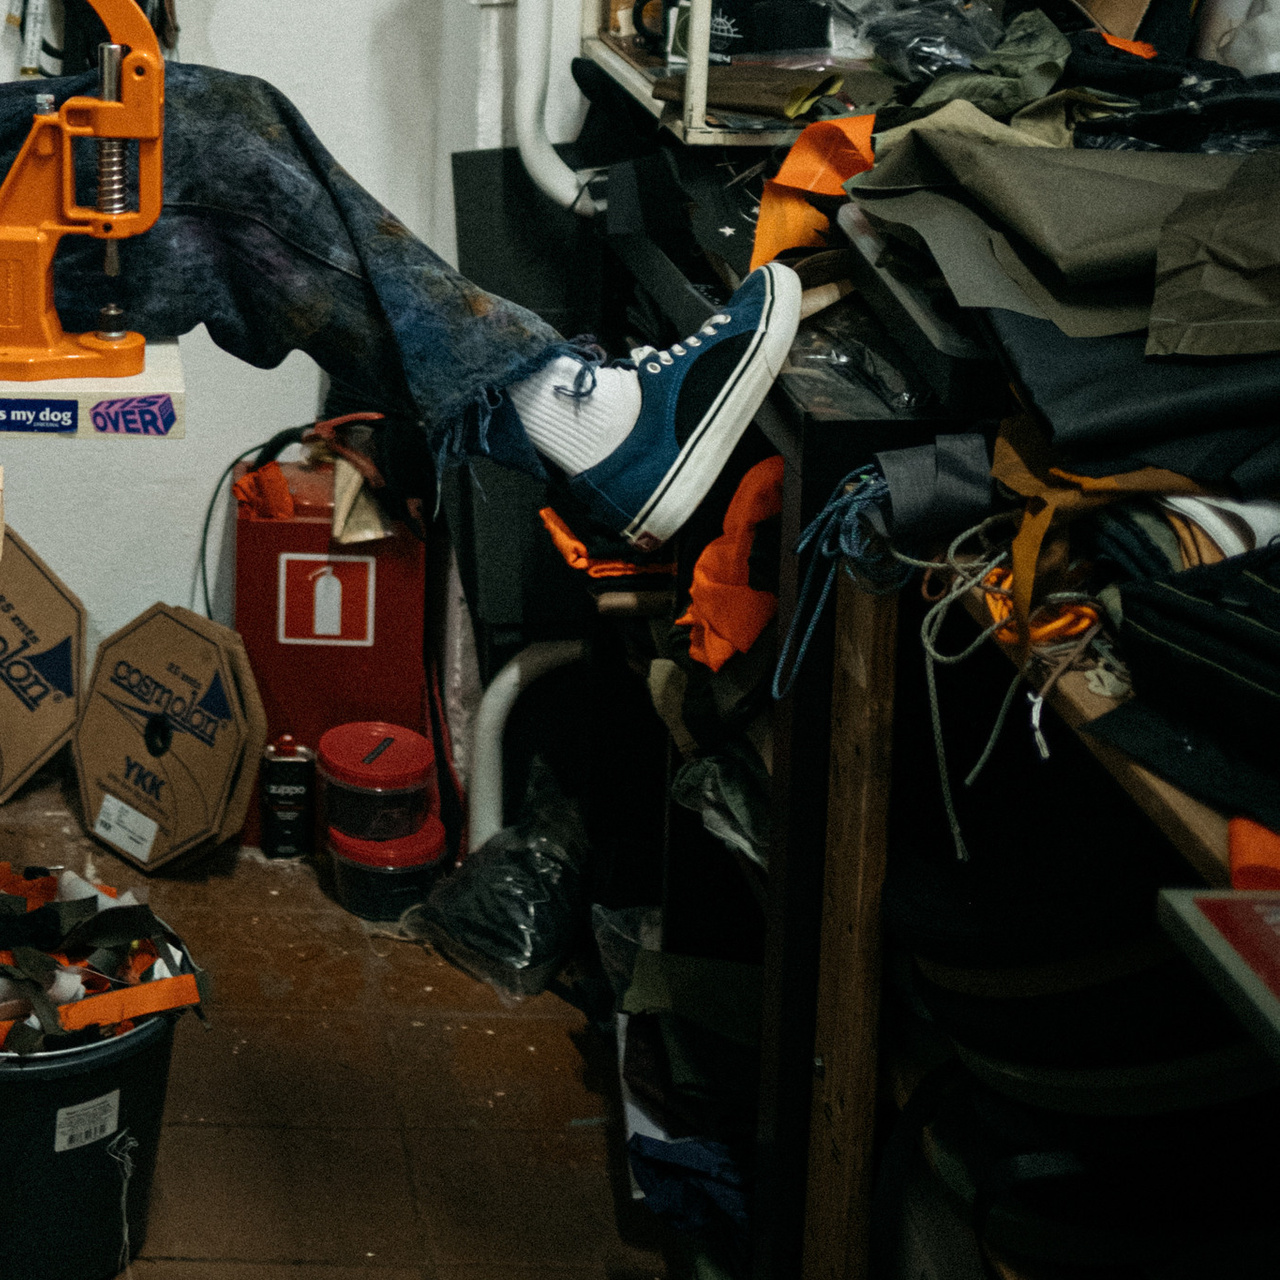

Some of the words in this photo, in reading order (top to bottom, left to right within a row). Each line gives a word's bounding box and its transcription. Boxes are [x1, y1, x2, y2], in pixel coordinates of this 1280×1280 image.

[10, 410, 36, 425] my
[39, 407, 73, 426] dog
[92, 408, 166, 436] OVER
[11, 613, 41, 645] mts
[123, 755, 167, 801] YKK
